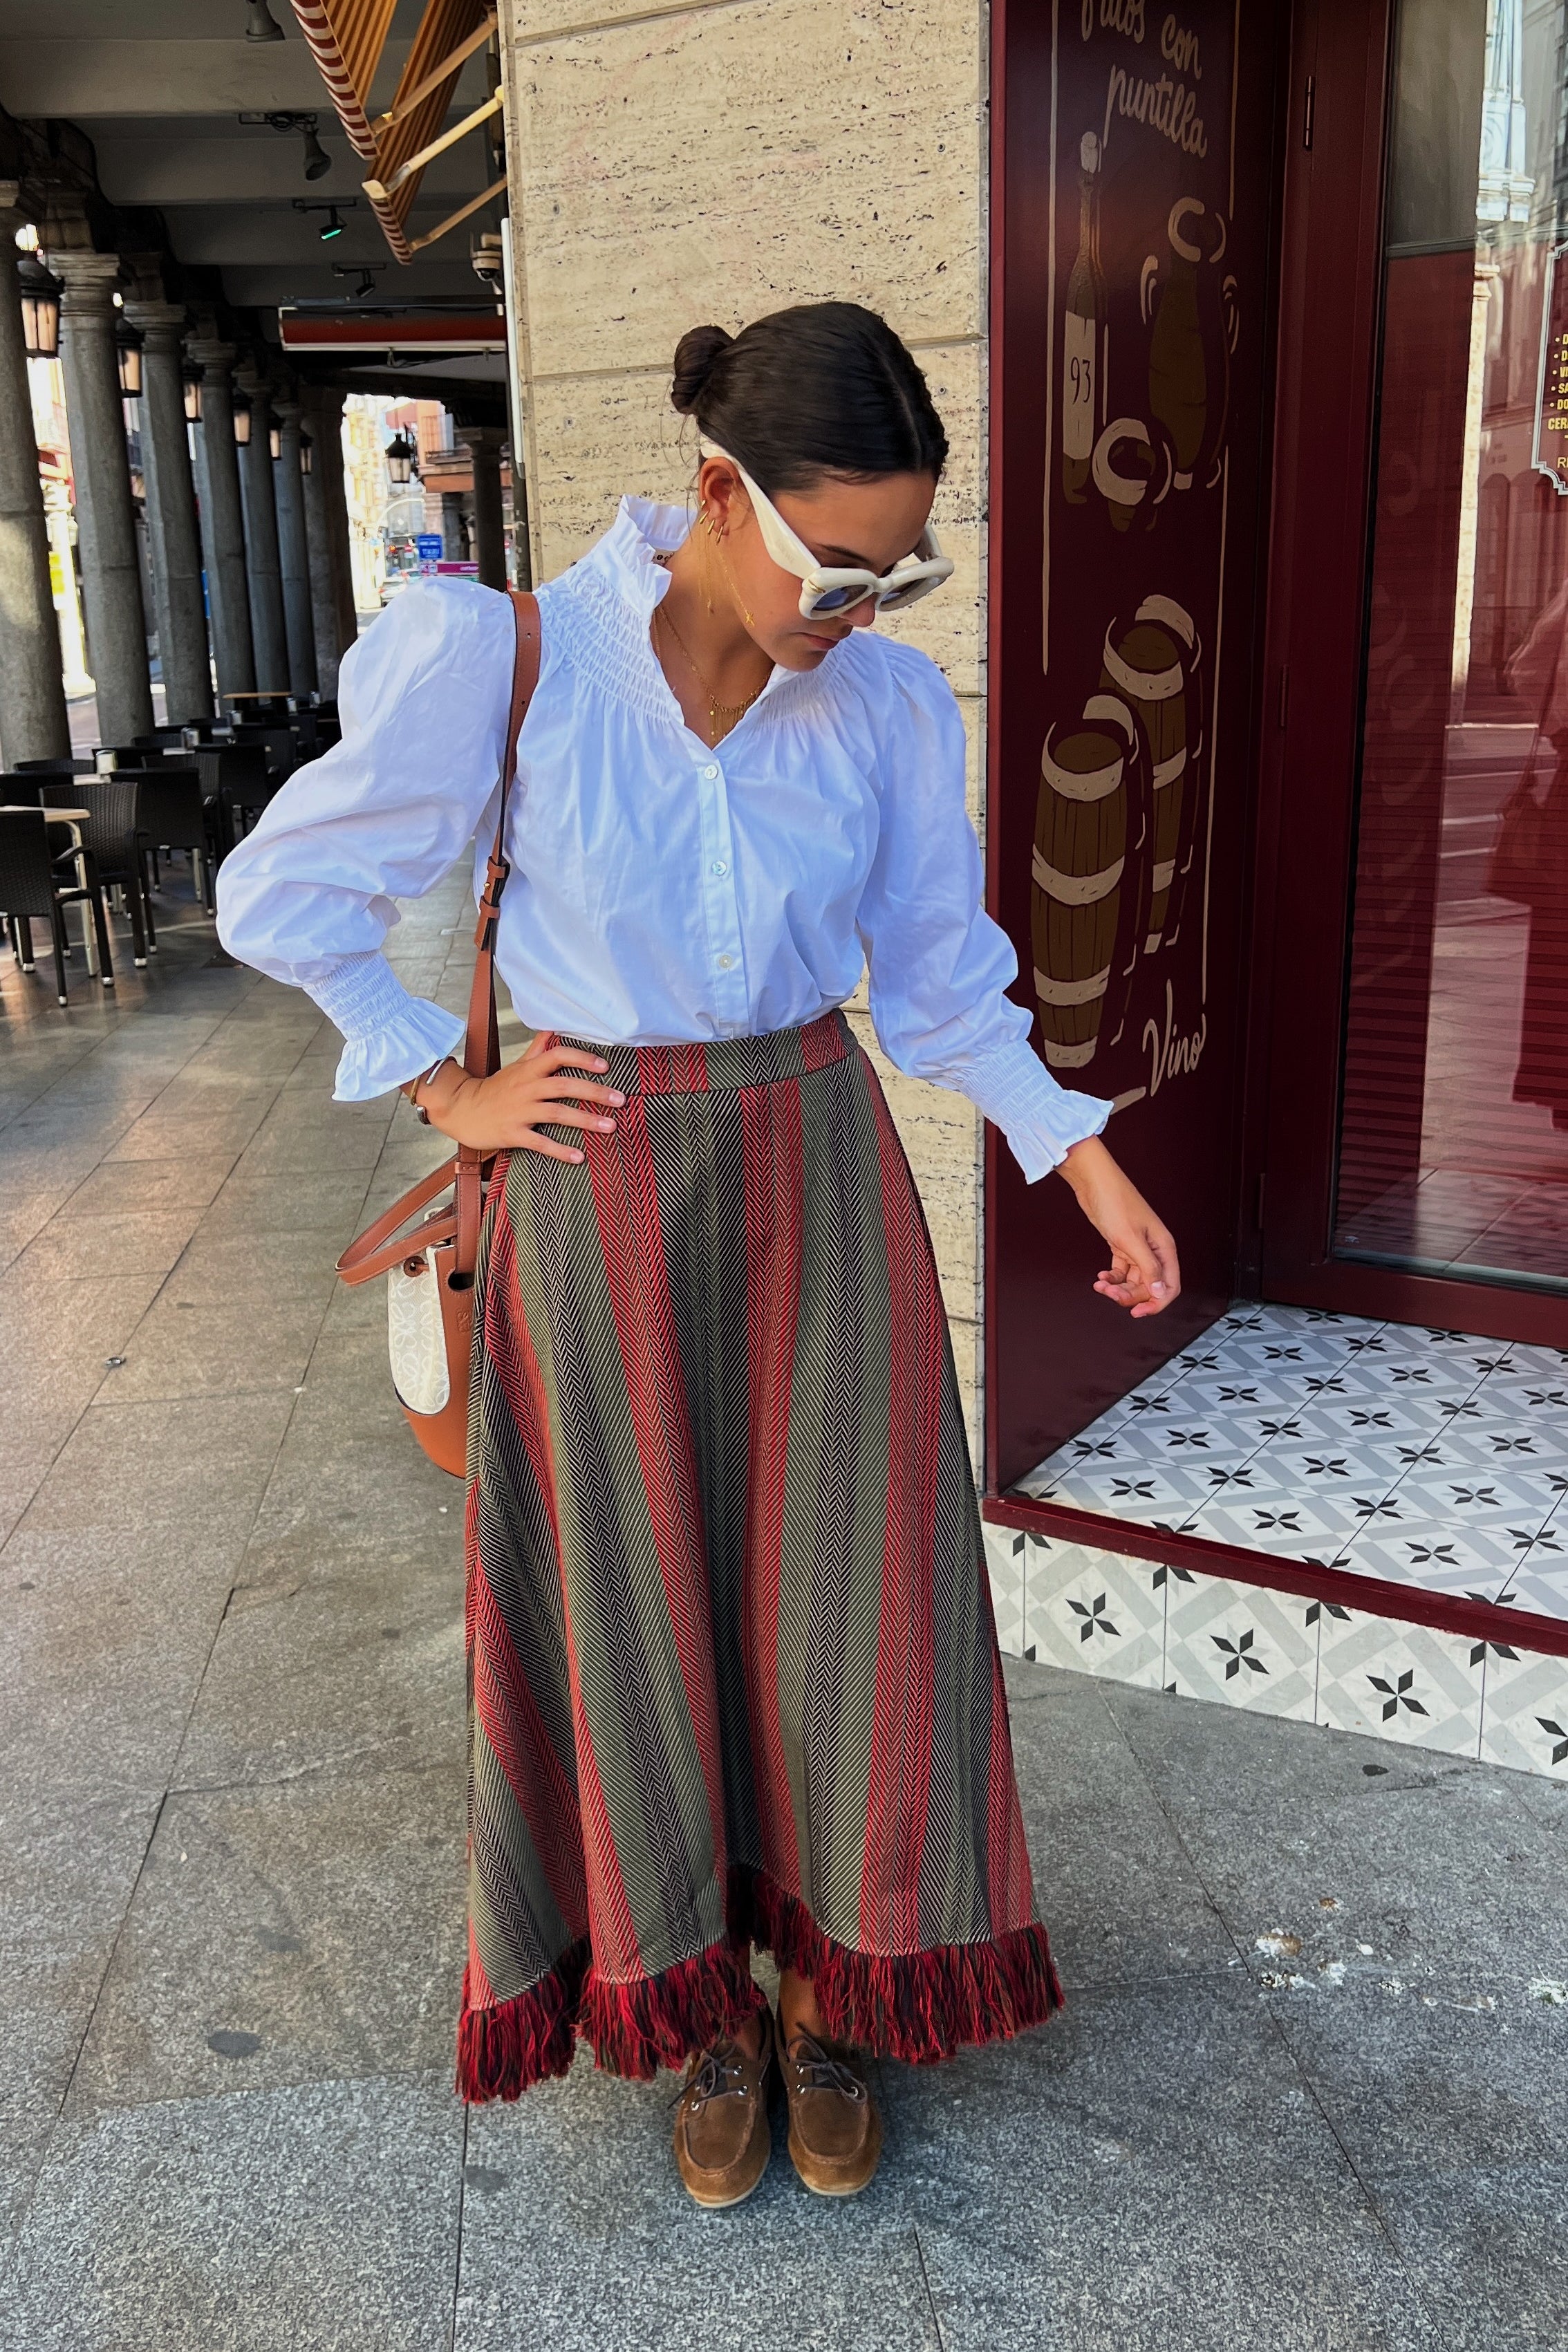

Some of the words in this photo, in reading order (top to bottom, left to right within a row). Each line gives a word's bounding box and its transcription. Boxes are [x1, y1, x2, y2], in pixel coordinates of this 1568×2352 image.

[1104, 65, 1207, 158] puntilla
[1071, 357, 1091, 404] 93
[1143, 979, 1206, 1096] Vino
